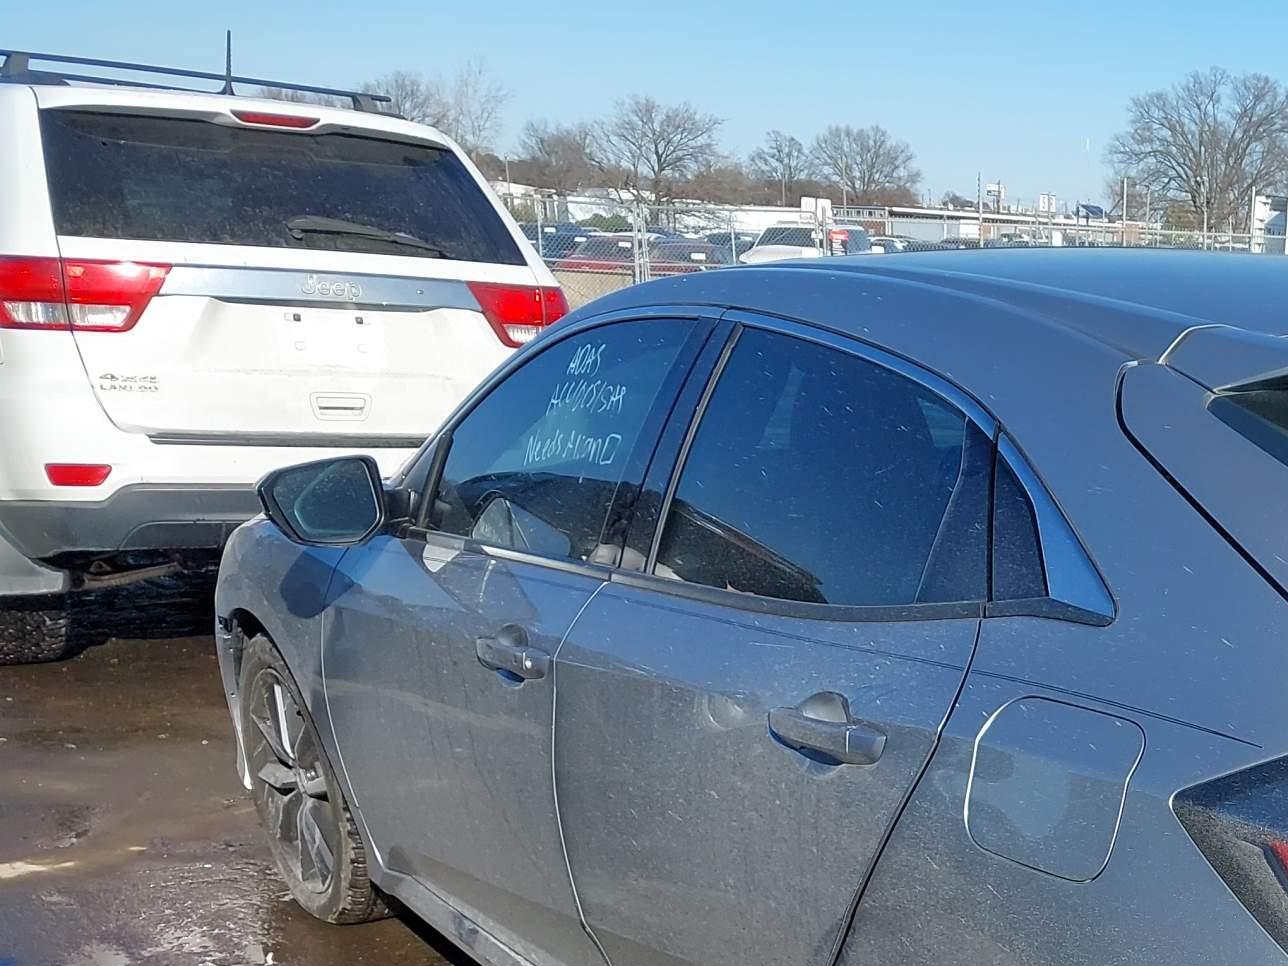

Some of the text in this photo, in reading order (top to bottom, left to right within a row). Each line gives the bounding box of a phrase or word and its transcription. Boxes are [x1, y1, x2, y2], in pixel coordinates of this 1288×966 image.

[301, 273, 361, 302] Jeep
[566, 343, 606, 378] ADAS
[523, 429, 564, 466] Needs
